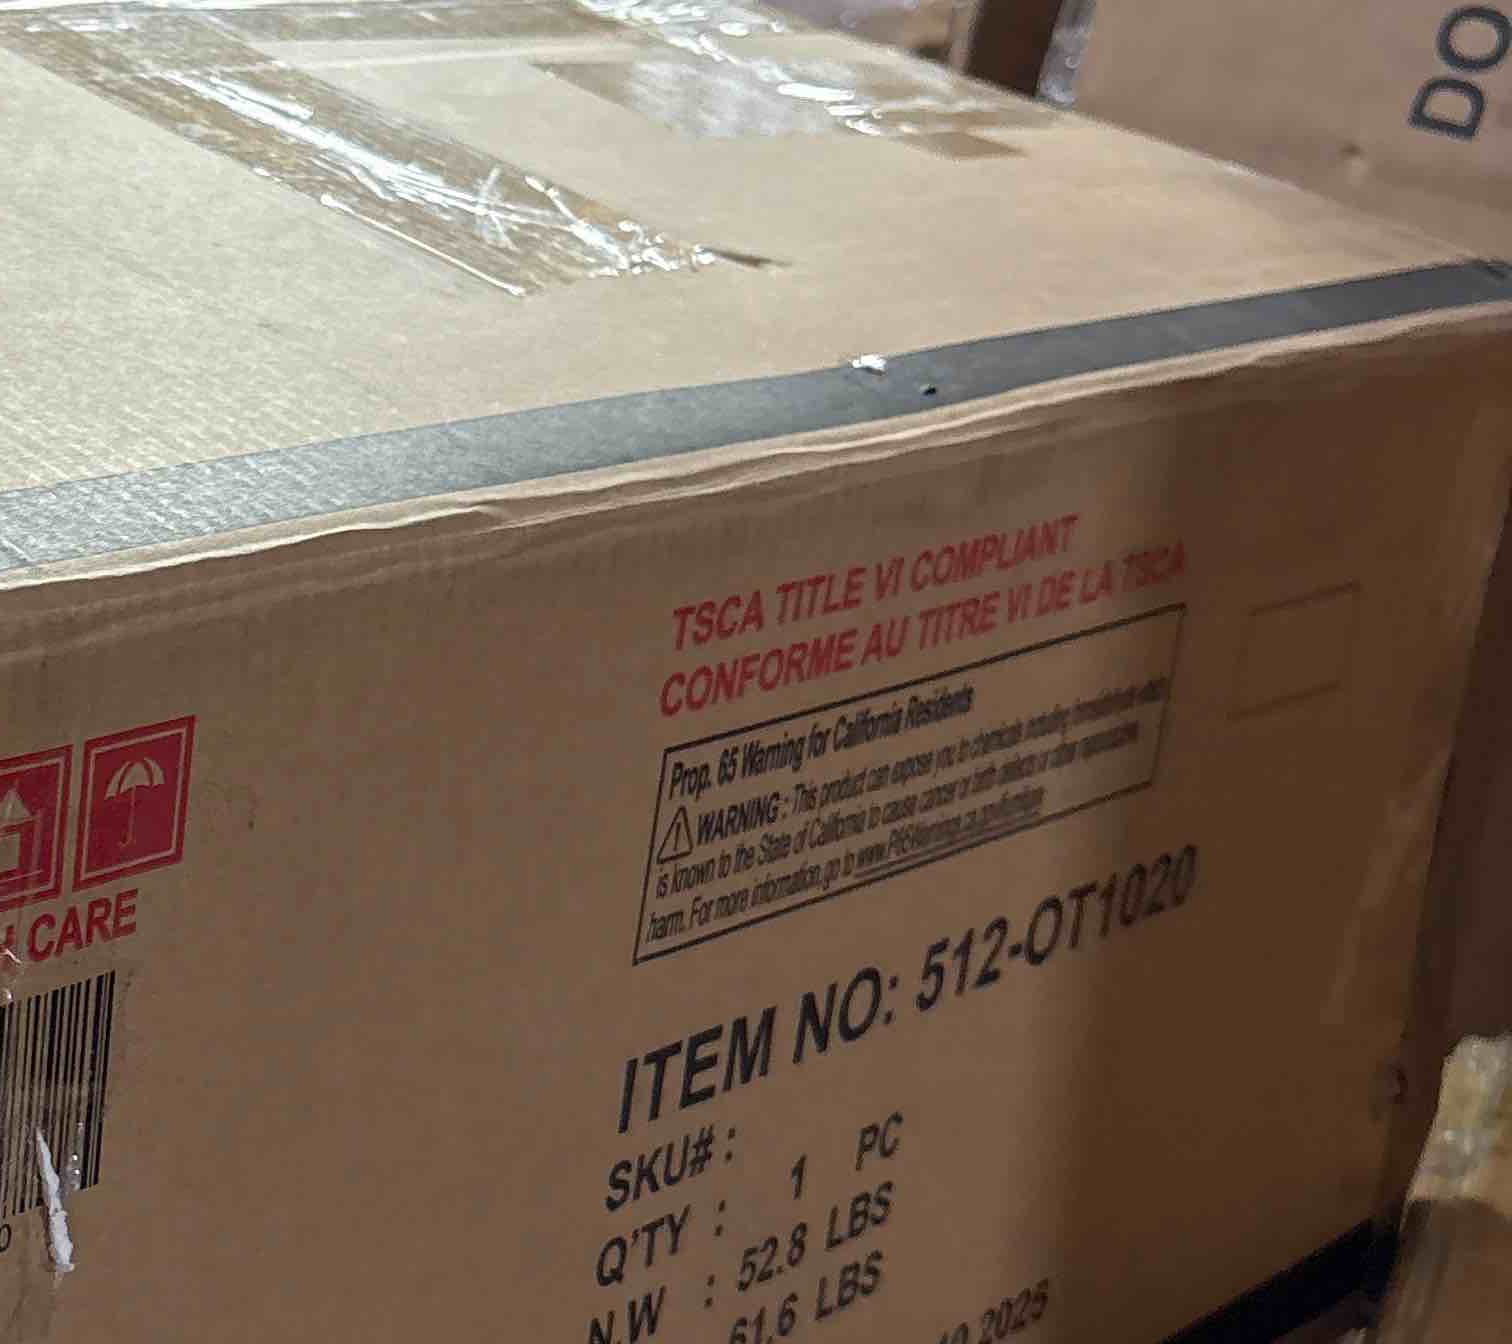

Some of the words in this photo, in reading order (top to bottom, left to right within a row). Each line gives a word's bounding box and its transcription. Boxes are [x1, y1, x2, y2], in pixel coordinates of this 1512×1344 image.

[1409, 4, 1512, 143] DO
[659, 622, 858, 719] CONFORME
[860, 614, 912, 666] AU
[917, 590, 1001, 652] TITRE
[1006, 580, 1035, 625] VI
[1037, 570, 1075, 617] DE
[1079, 563, 1119, 607] LA
[1121, 540, 1188, 599] TSCA
[673, 588, 767, 652] TSCA
[775, 566, 868, 627] TITLE
[873, 554, 906, 601] VI
[909, 513, 1080, 594] COMPLIANT
[670, 761, 714, 801] Prop.
[717, 747, 739, 786] 65
[740, 734, 806, 778] Warning
[808, 722, 832, 759] for
[696, 791, 781, 845] WARNING
[26, 888, 140, 966] CARE
[618, 1004, 777, 1134] ITEM
[792, 965, 900, 1065] NO:
[916, 843, 1199, 1013] 512-OT1020
[594, 1205, 690, 1289] Q'TY
[789, 1155, 808, 1202] 1
[855, 1111, 904, 1173] PC
[736, 1220, 808, 1294] 52.8
[824, 1180, 896, 1253] LBS
[814, 1248, 885, 1324] LBS
